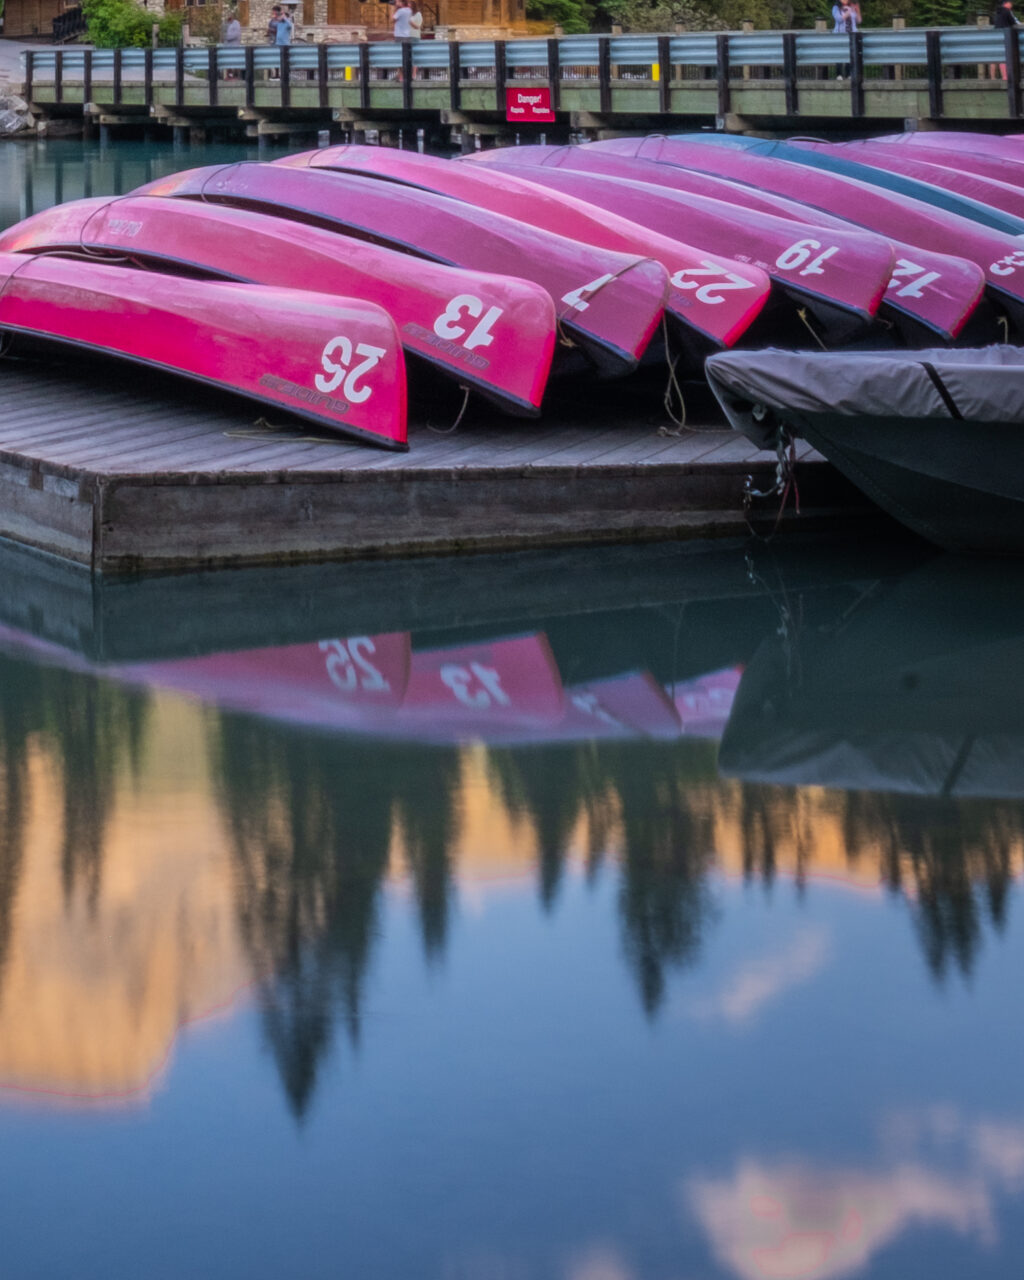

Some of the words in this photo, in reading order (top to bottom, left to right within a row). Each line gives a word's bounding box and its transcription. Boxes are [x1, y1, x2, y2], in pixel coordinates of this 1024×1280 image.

[518, 94, 541, 105] Danger!
[775, 239, 840, 276] 19
[670, 260, 756, 304] 22
[433, 294, 504, 350] 13
[315, 336, 387, 403] 26
